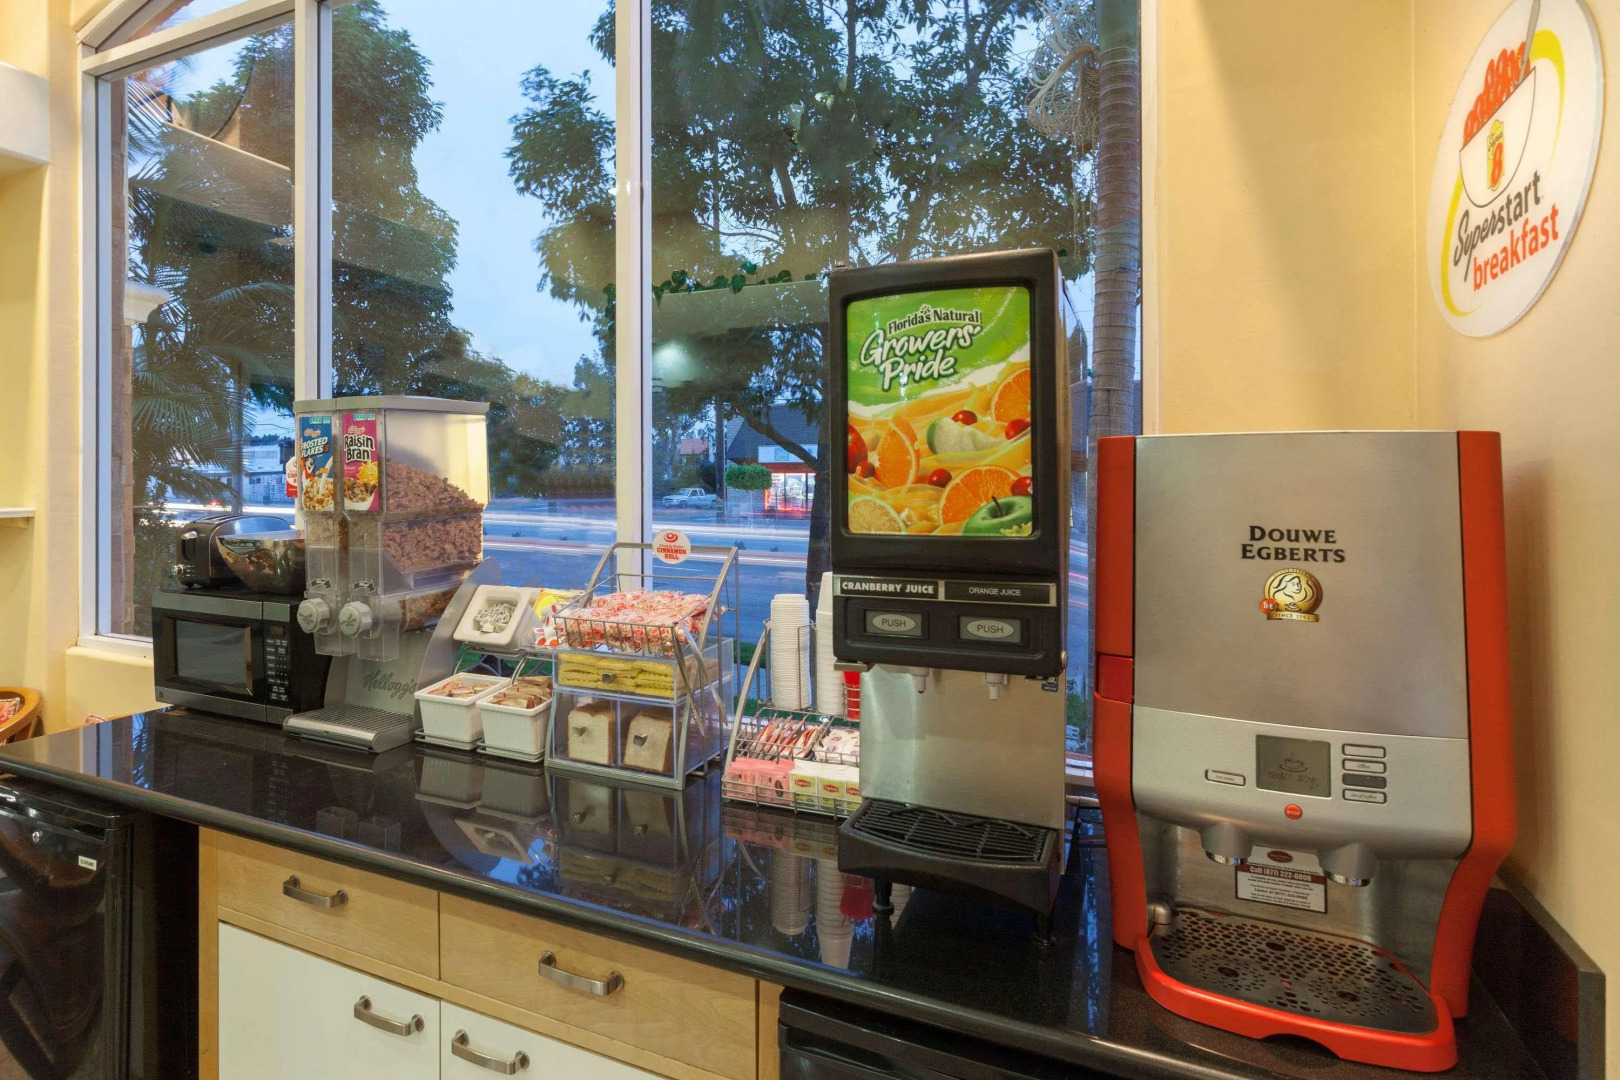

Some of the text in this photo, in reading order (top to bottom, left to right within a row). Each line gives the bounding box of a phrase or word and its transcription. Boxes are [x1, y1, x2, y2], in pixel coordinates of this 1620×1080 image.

[1453, 172, 1541, 283] Superstart
[1473, 203, 1559, 292] breakfast
[878, 347, 957, 392] Pride
[301, 436, 328, 451] FROSTED
[344, 434, 375, 451] Raisin
[301, 445, 324, 458] FLAKES
[345, 447, 371, 462] Bran
[1249, 525, 1337, 544] DOUWE
[656, 547, 687, 555] CINNAMON
[664, 553, 680, 561] ROLL
[1240, 543, 1346, 563] EGBERTS
[842, 581, 934, 594] CRANBERRY JUICE
[968, 586, 1022, 597] ORANGE JUICE
[881, 618, 907, 628] PUSH
[976, 624, 1004, 634] PUSH
[362, 669, 418, 700] Kellogg's
[1249, 865, 1263, 874] Call
[1263, 867, 1279, 877] (877)
